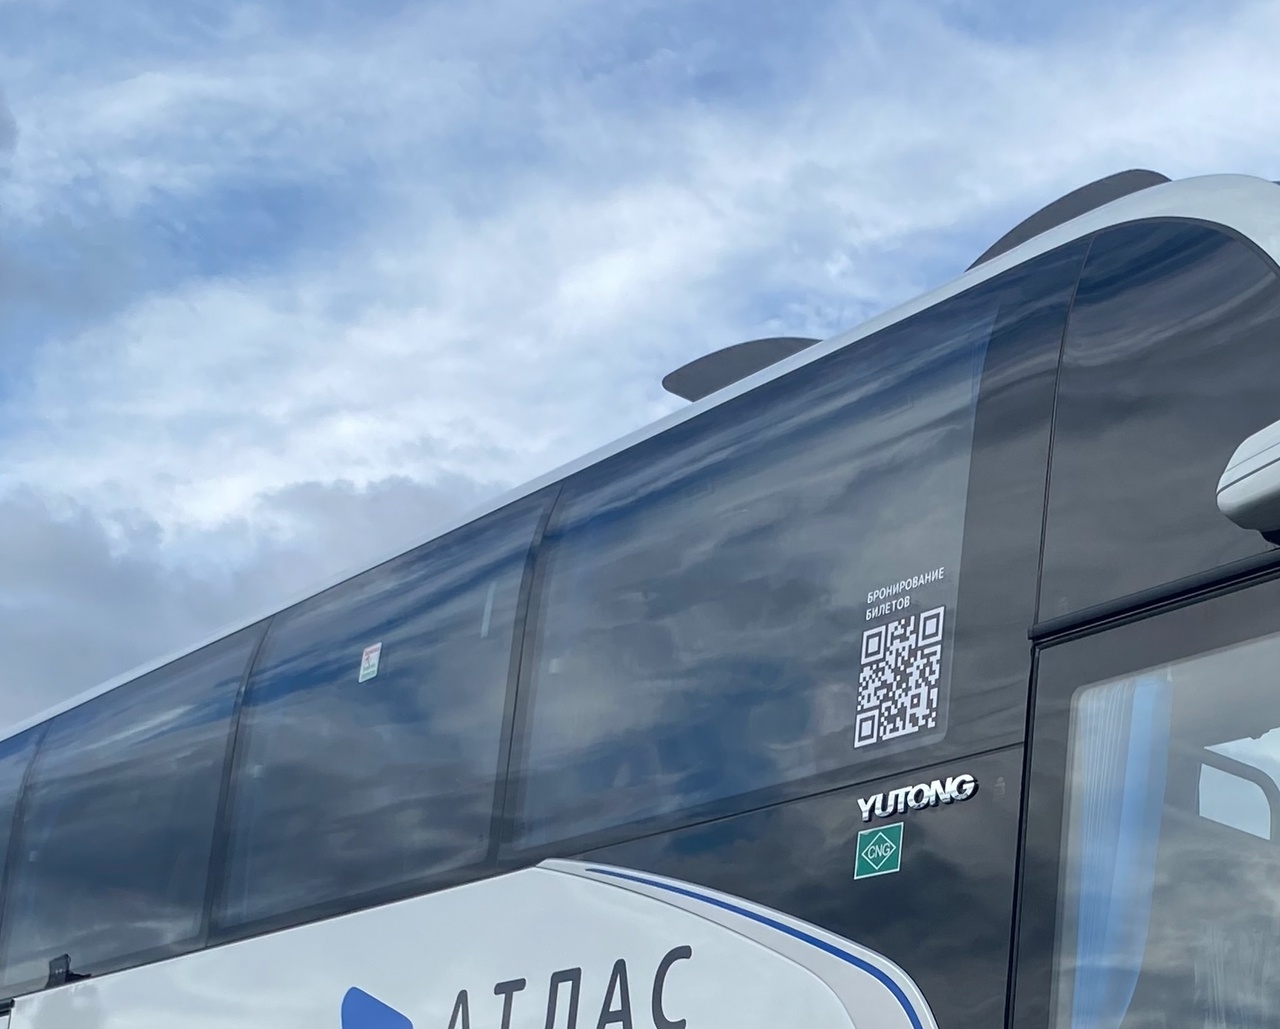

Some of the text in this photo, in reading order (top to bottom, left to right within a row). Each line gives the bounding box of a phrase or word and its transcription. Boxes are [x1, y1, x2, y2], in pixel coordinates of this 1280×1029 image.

[867, 567, 945, 604] БРОНИРОВАНИЕ
[865, 595, 911, 621] БИЛЕТОВ
[857, 773, 978, 821] YUTONG
[867, 842, 892, 859] CNG
